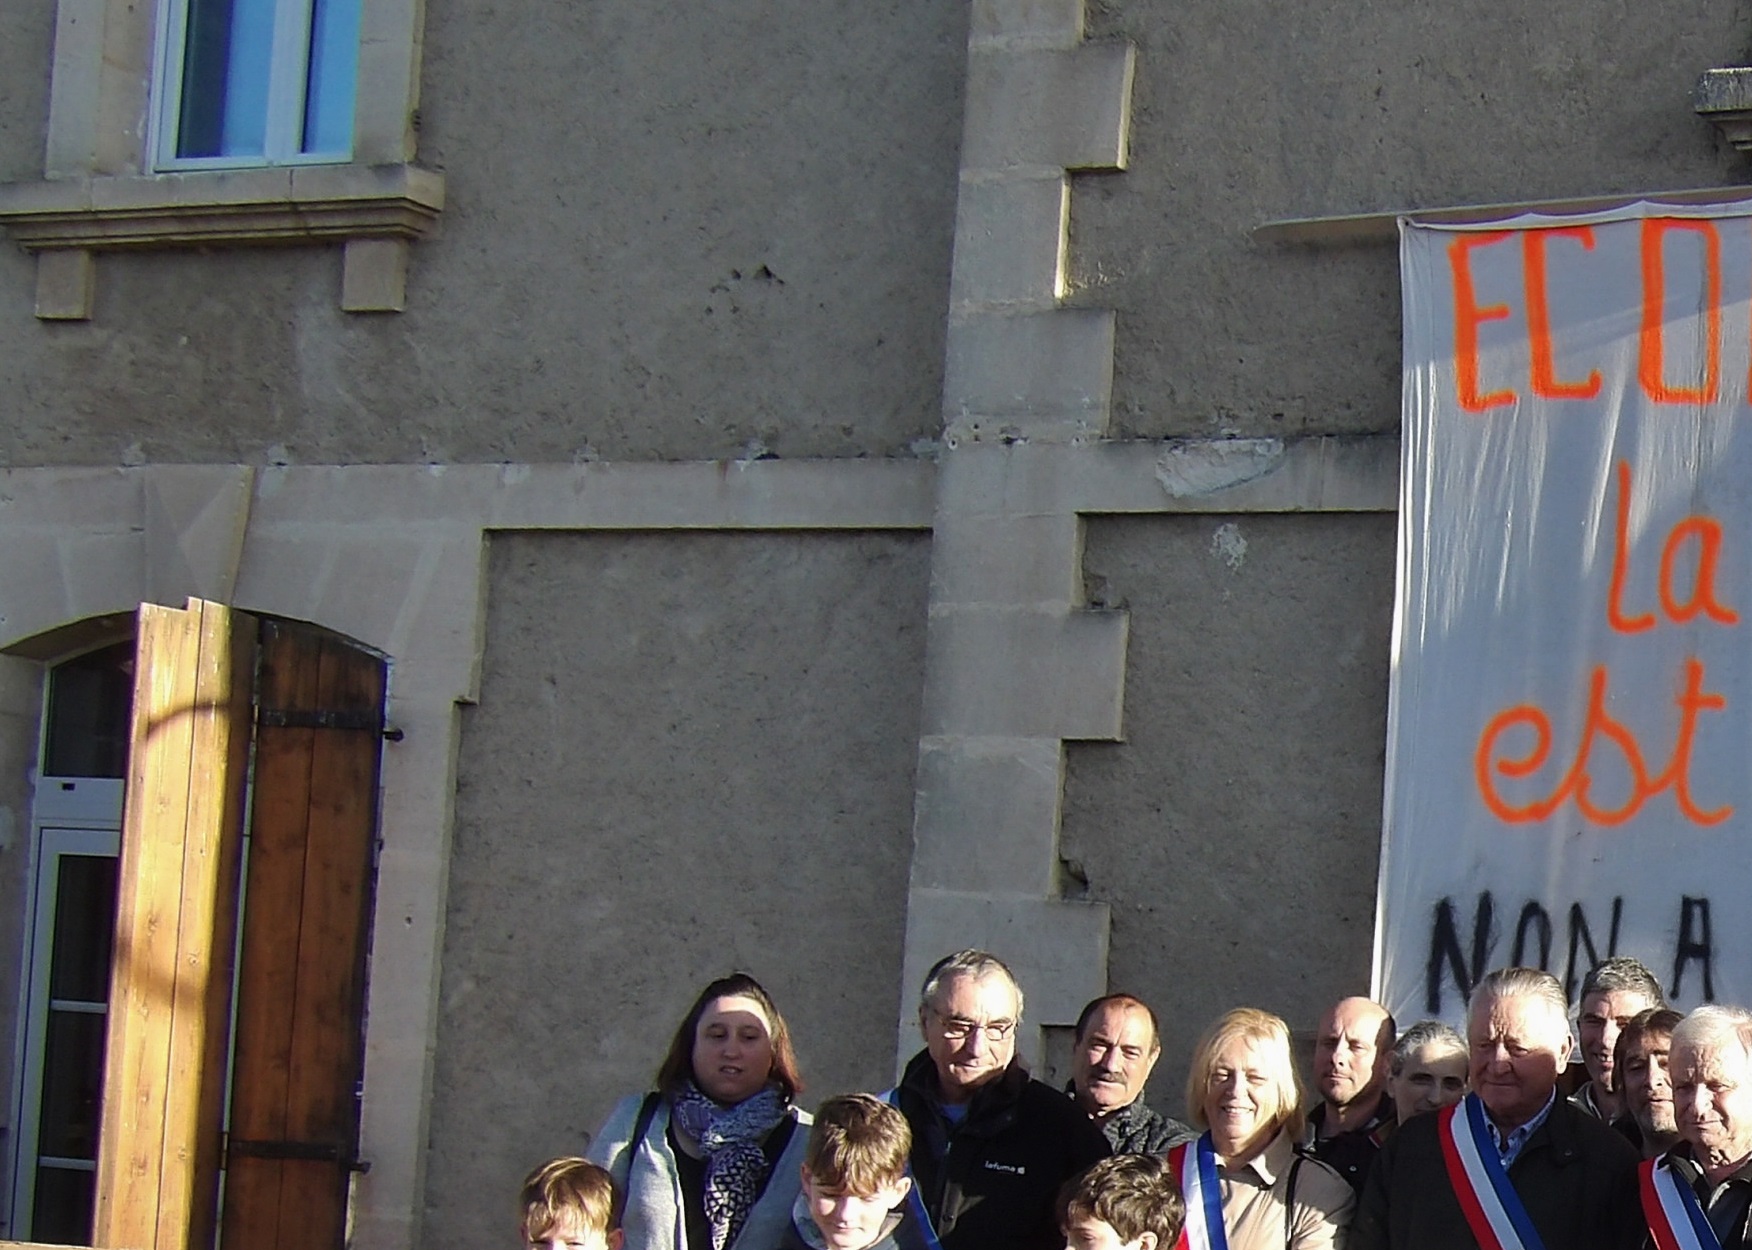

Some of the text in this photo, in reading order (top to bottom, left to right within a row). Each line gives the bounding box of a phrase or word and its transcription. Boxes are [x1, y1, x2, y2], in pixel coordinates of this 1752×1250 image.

[1608, 458, 1738, 632] la
[1474, 650, 1732, 824] est
[1428, 892, 1624, 1012] NON
[1672, 894, 1720, 1002] A
